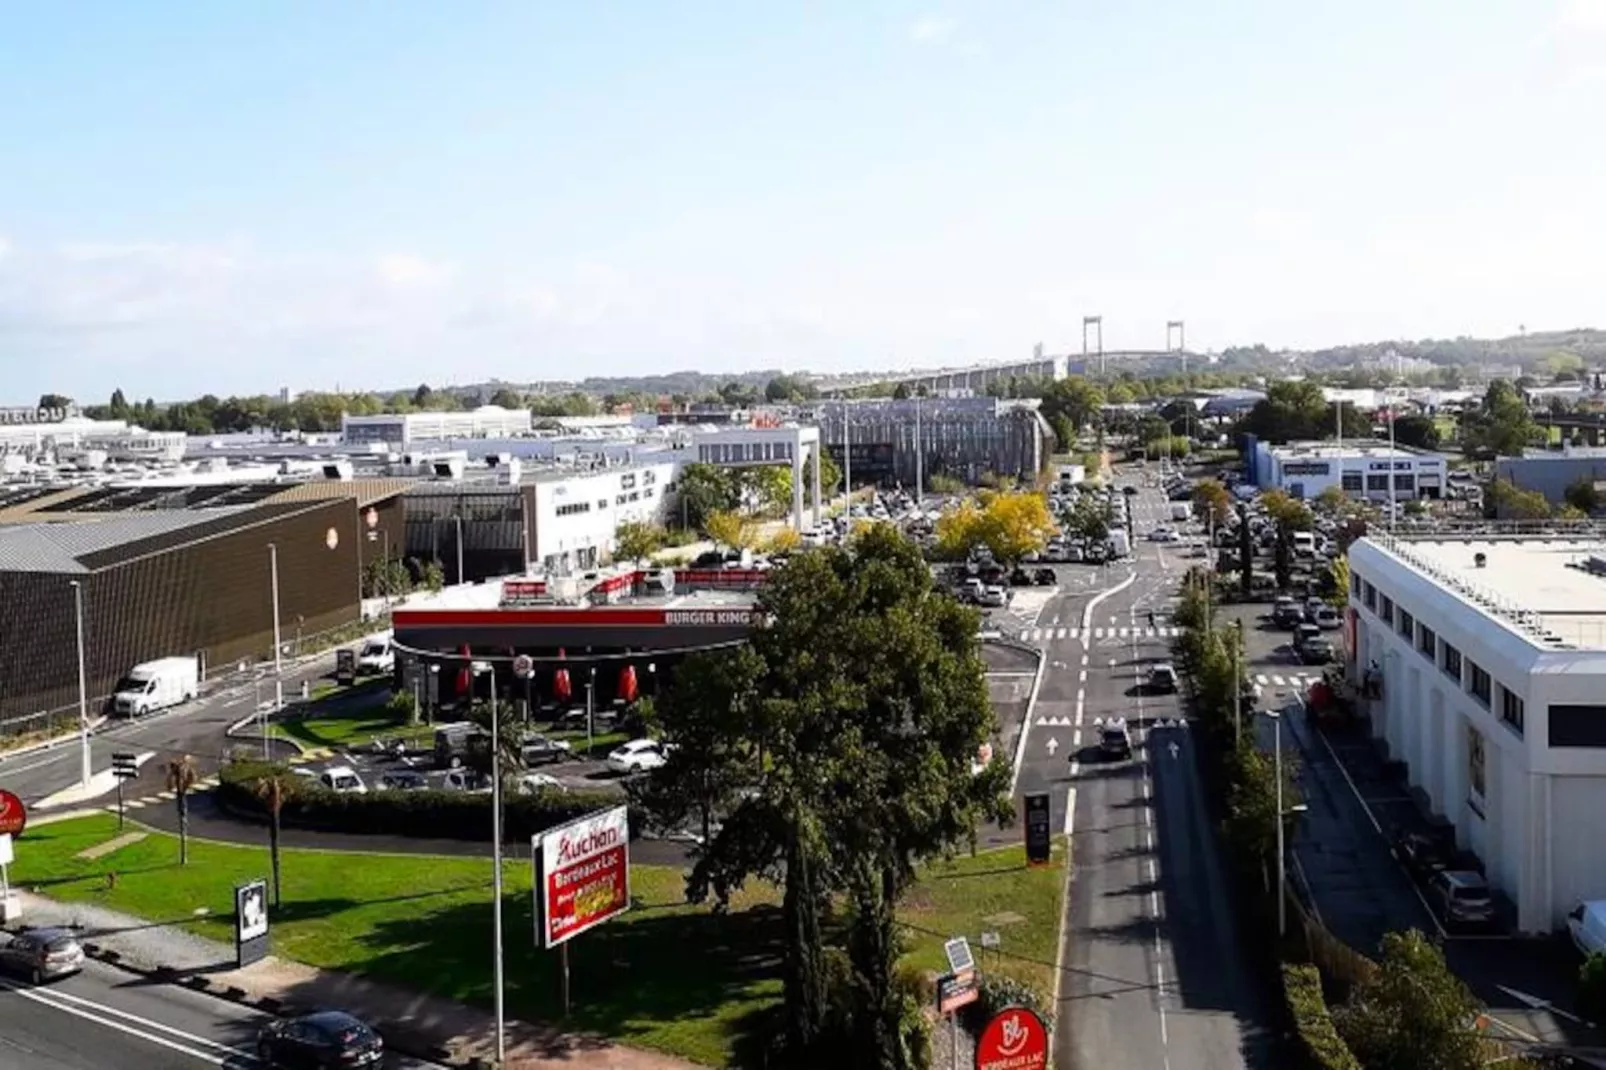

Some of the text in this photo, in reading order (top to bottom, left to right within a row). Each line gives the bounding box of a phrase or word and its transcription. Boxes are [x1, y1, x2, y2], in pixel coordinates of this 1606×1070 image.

[665, 612, 750, 625] BURGER KING
[556, 827, 617, 864] Auchan
[555, 858, 601, 888] Bordeaux
